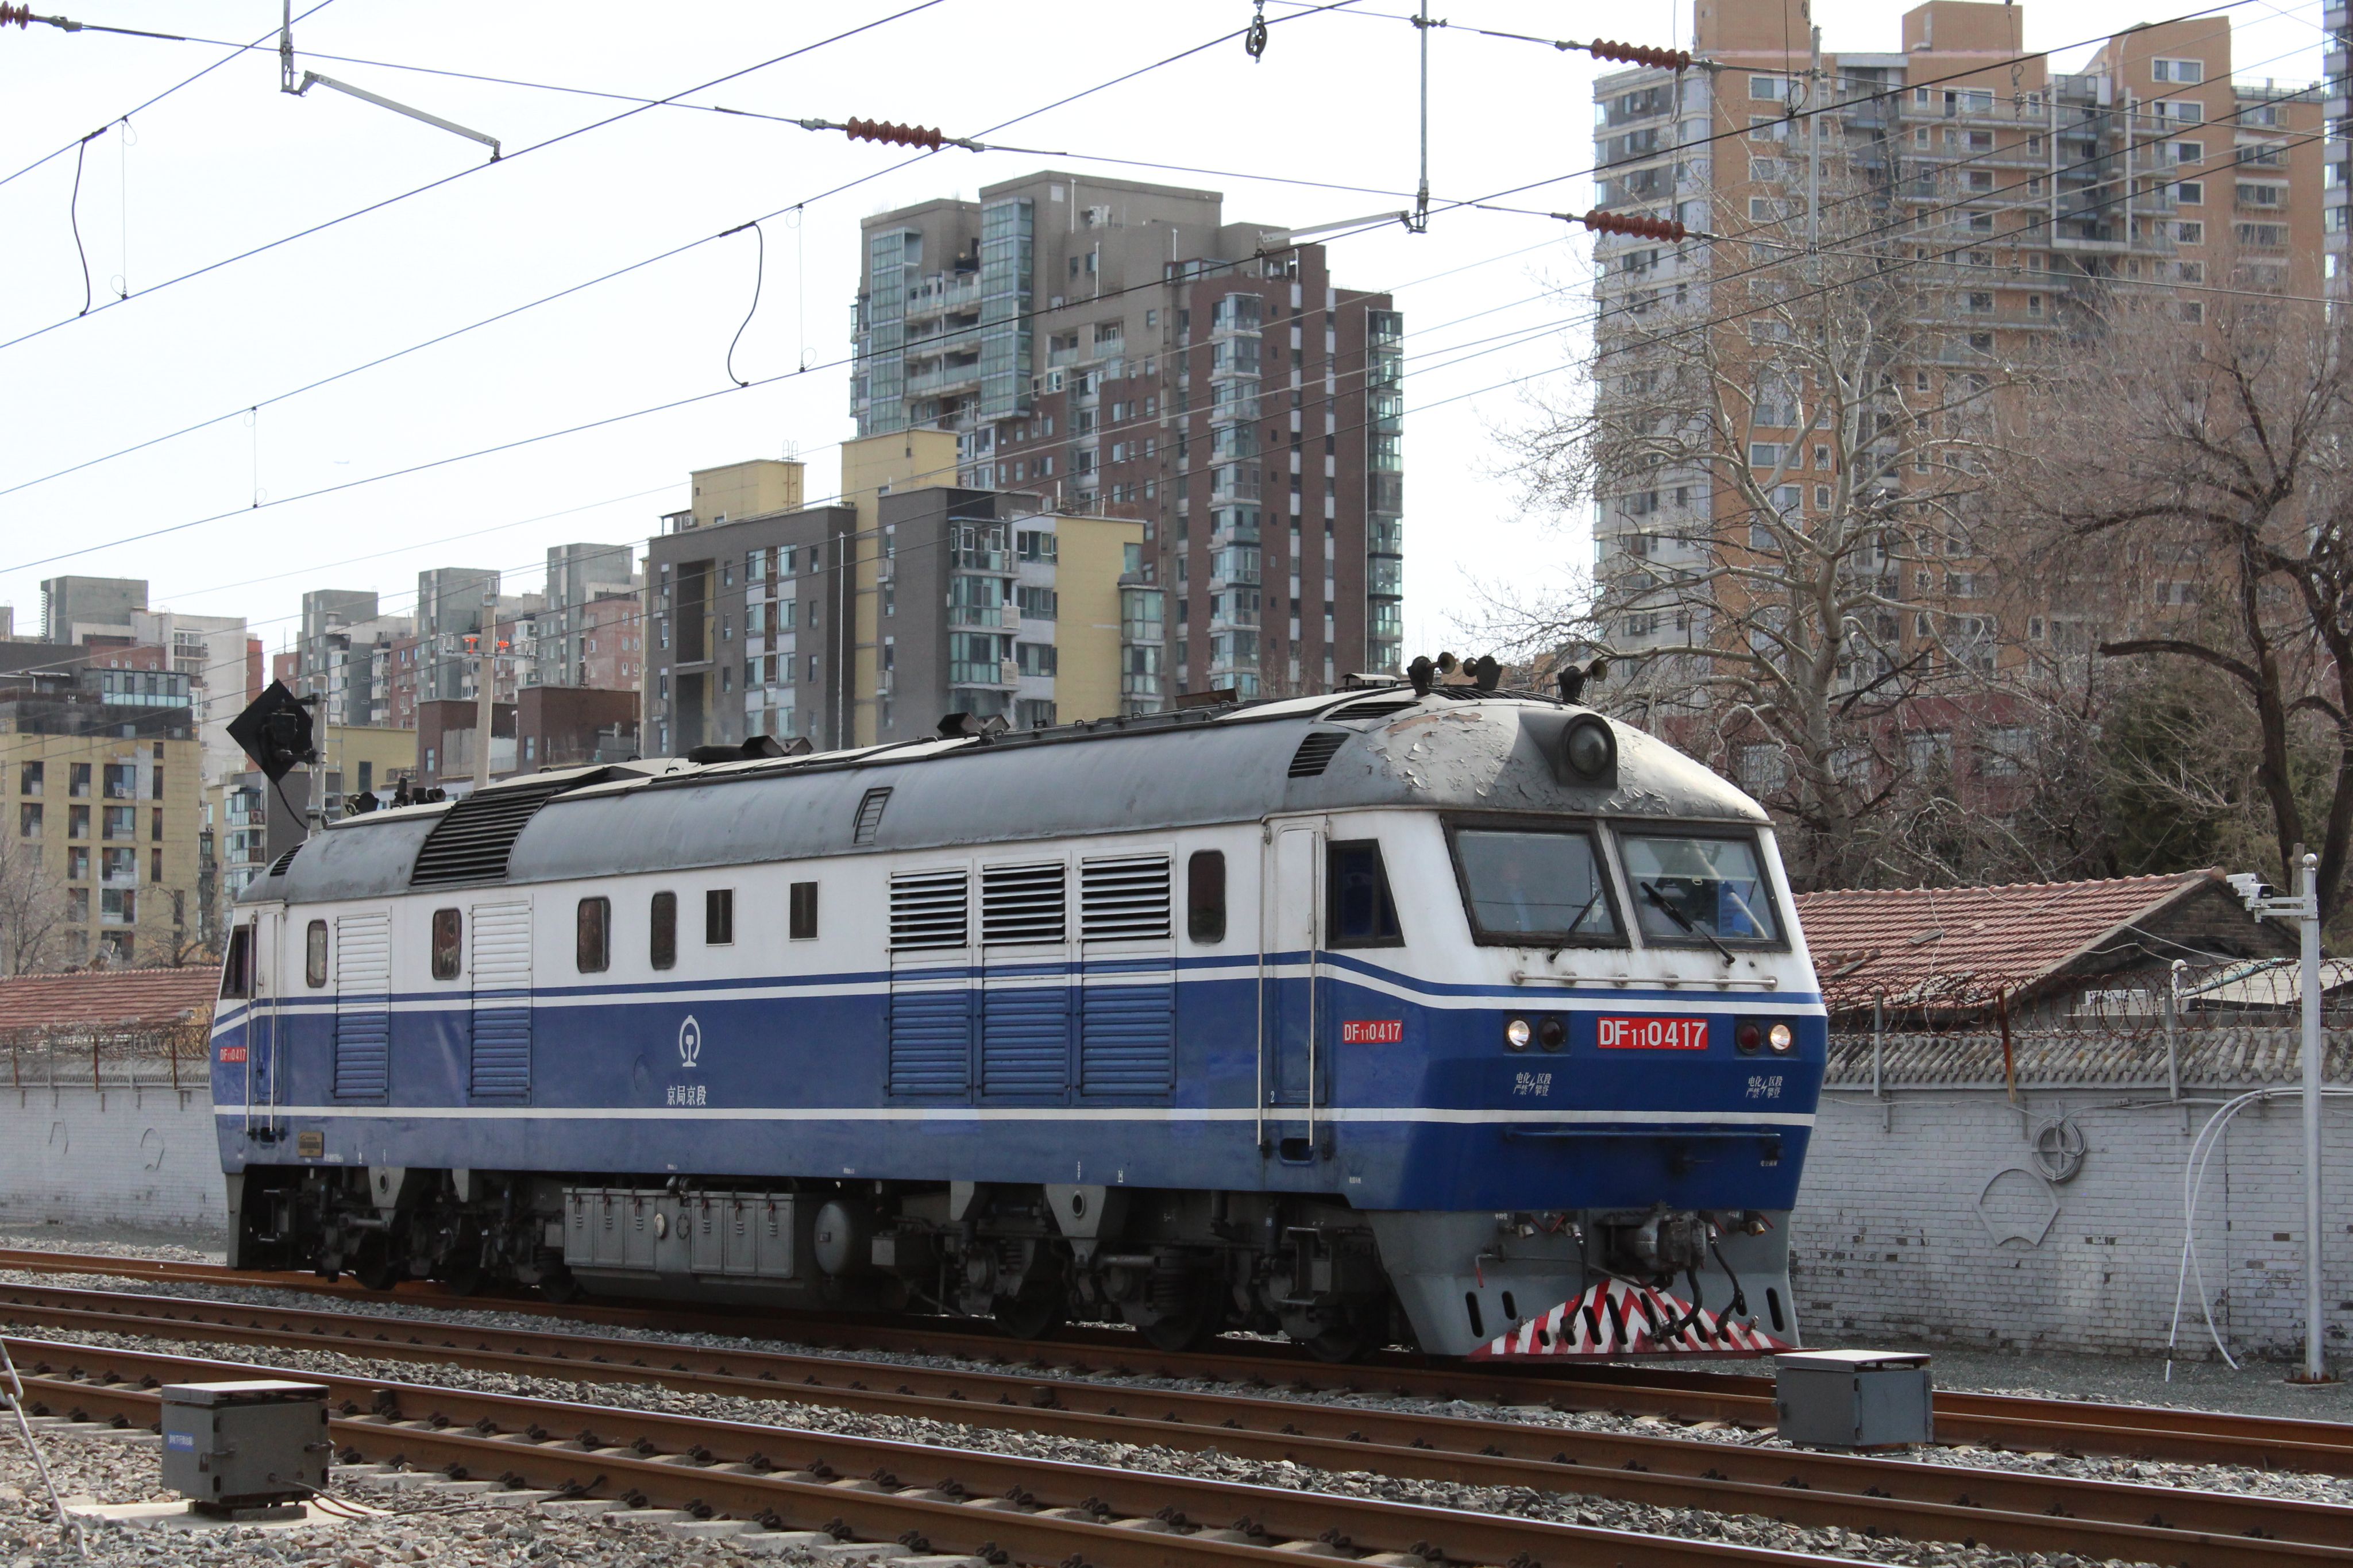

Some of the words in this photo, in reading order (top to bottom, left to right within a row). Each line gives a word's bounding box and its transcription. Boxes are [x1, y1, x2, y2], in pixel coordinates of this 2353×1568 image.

[1345, 1024, 1401, 1040] DF110417
[1600, 1019, 1707, 1046] DF110417
[666, 1085, 707, 1106] 京局京段
[1270, 1090, 1275, 1103] 2
